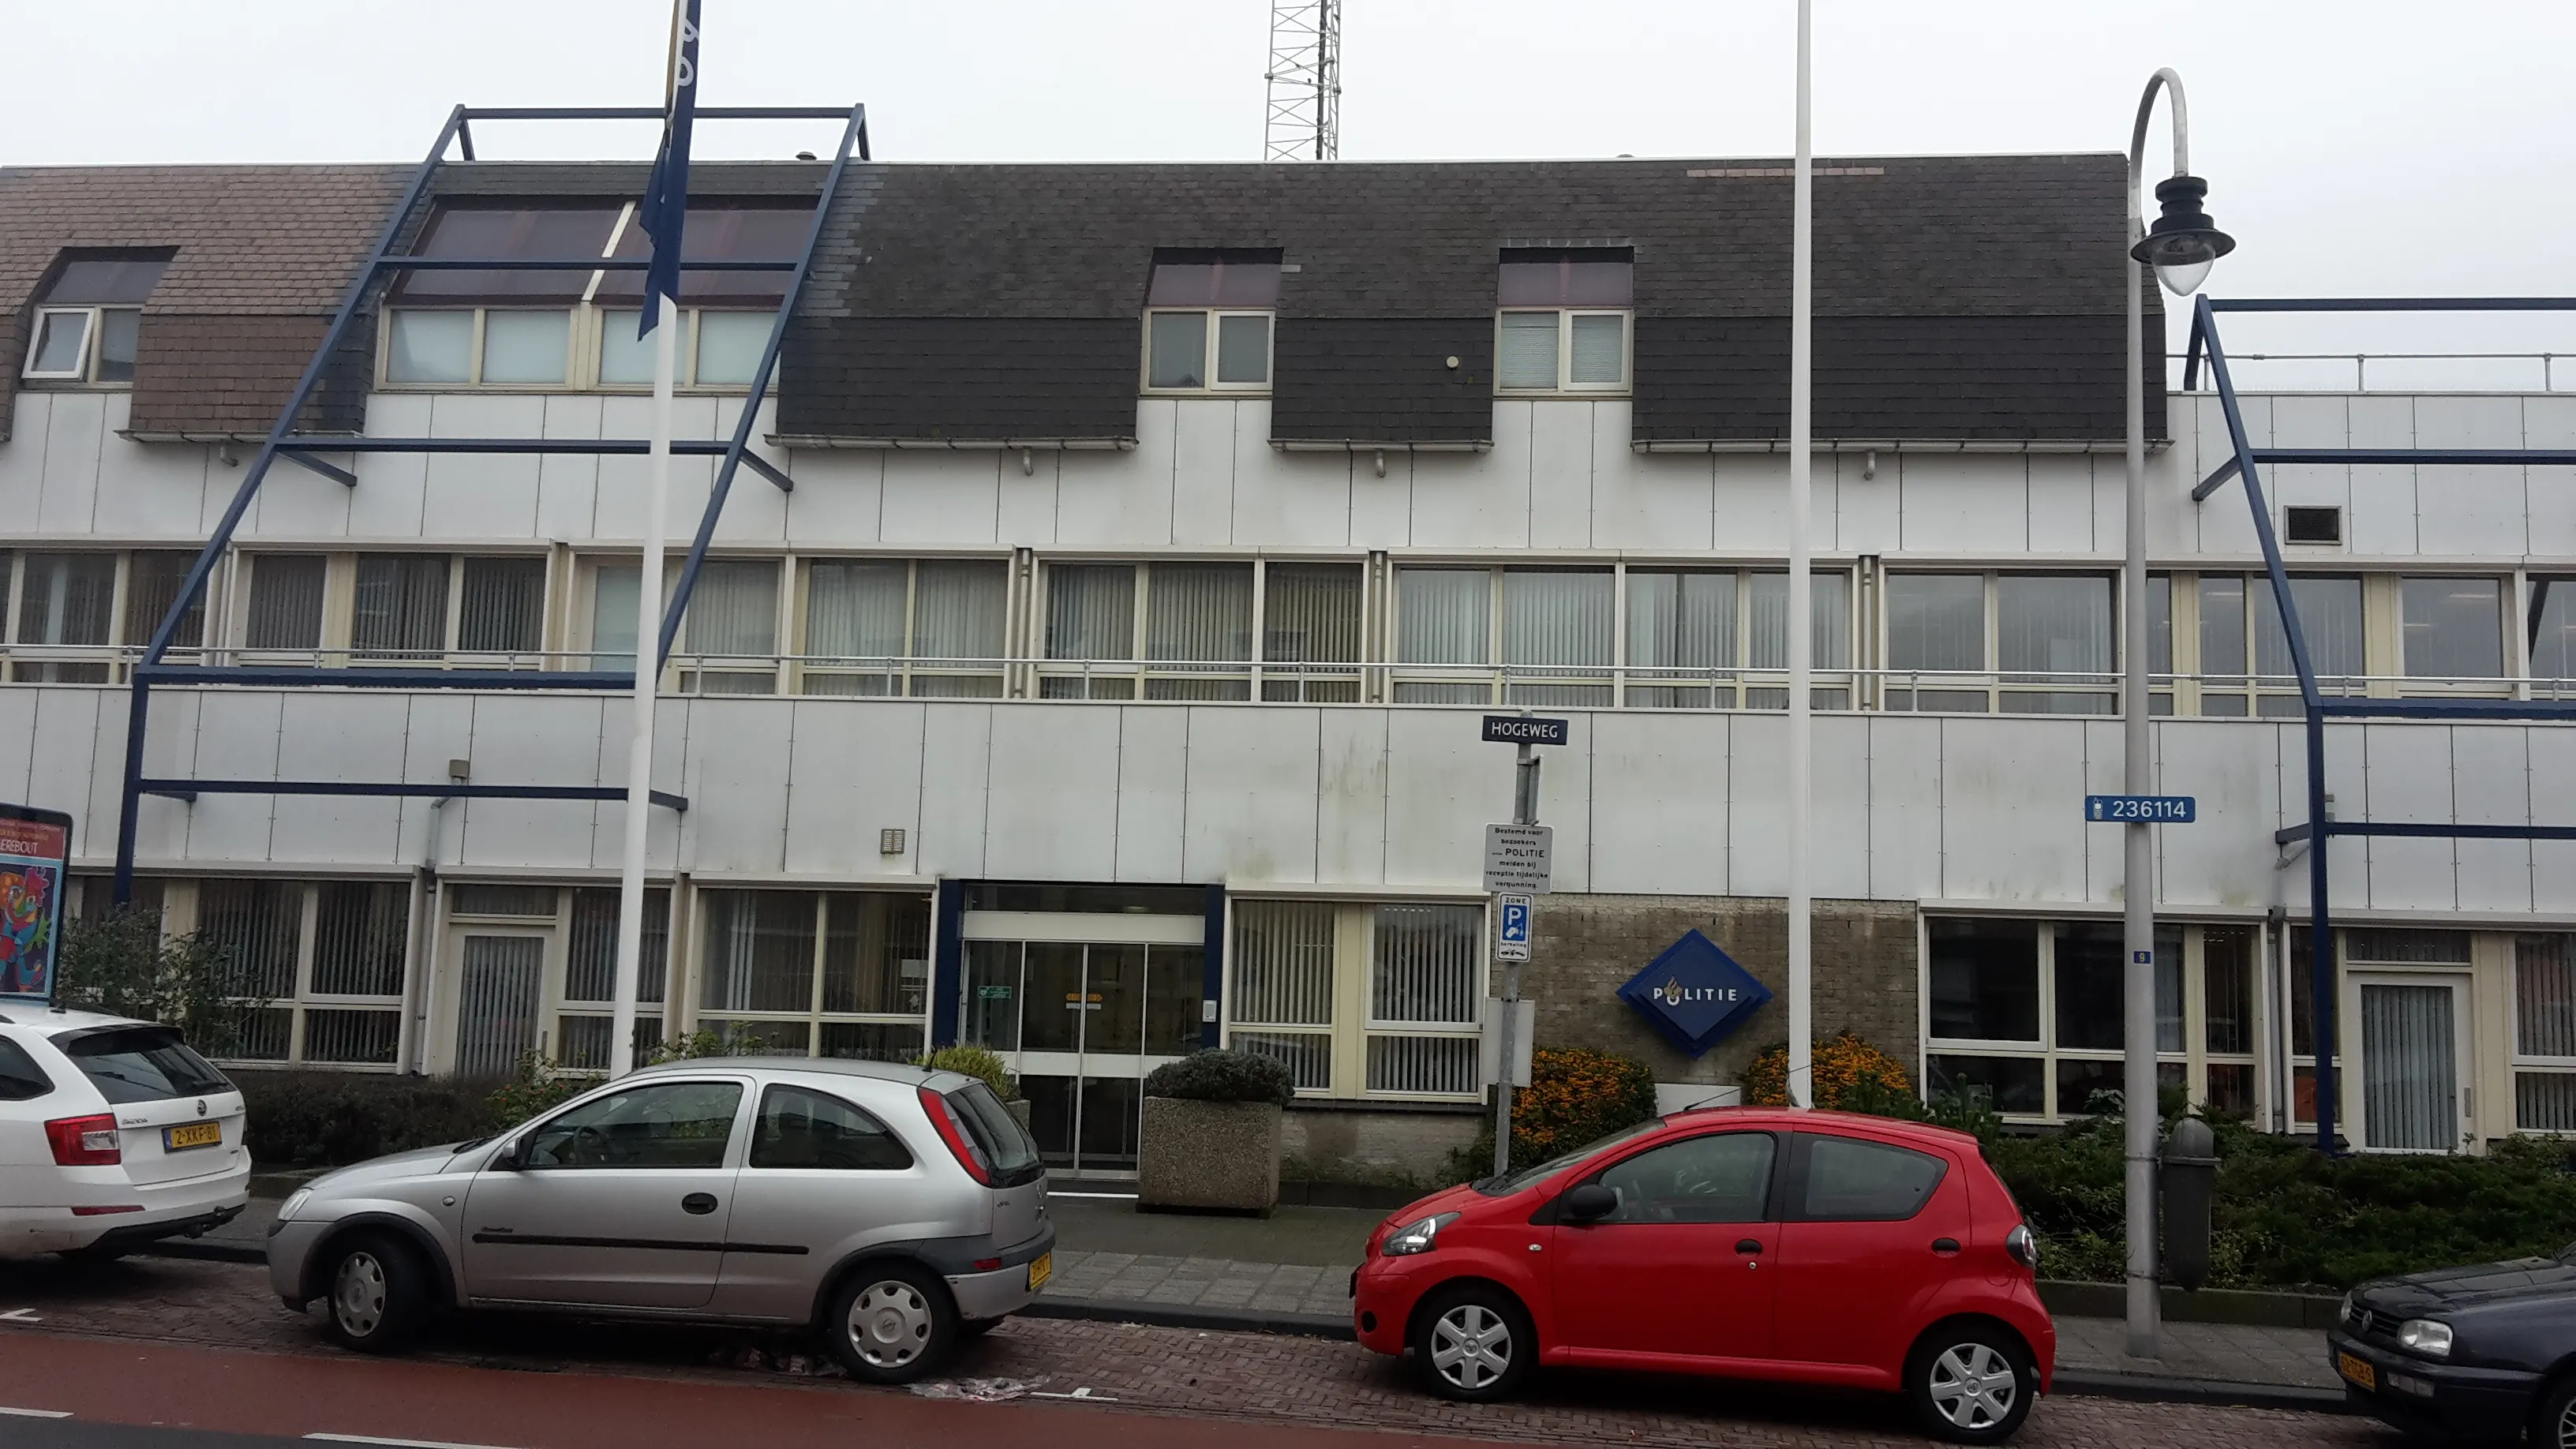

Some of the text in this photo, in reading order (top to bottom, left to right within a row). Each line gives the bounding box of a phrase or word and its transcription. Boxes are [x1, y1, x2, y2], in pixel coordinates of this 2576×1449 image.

[1491, 721, 1558, 738] HOGEWEG
[2113, 800, 2186, 818] 236114
[0, 839, 38, 853] EREBOUT
[1505, 848, 1544, 857] POLITIE
[1507, 907, 1522, 925] P
[1653, 987, 1737, 1006] POLITIE
